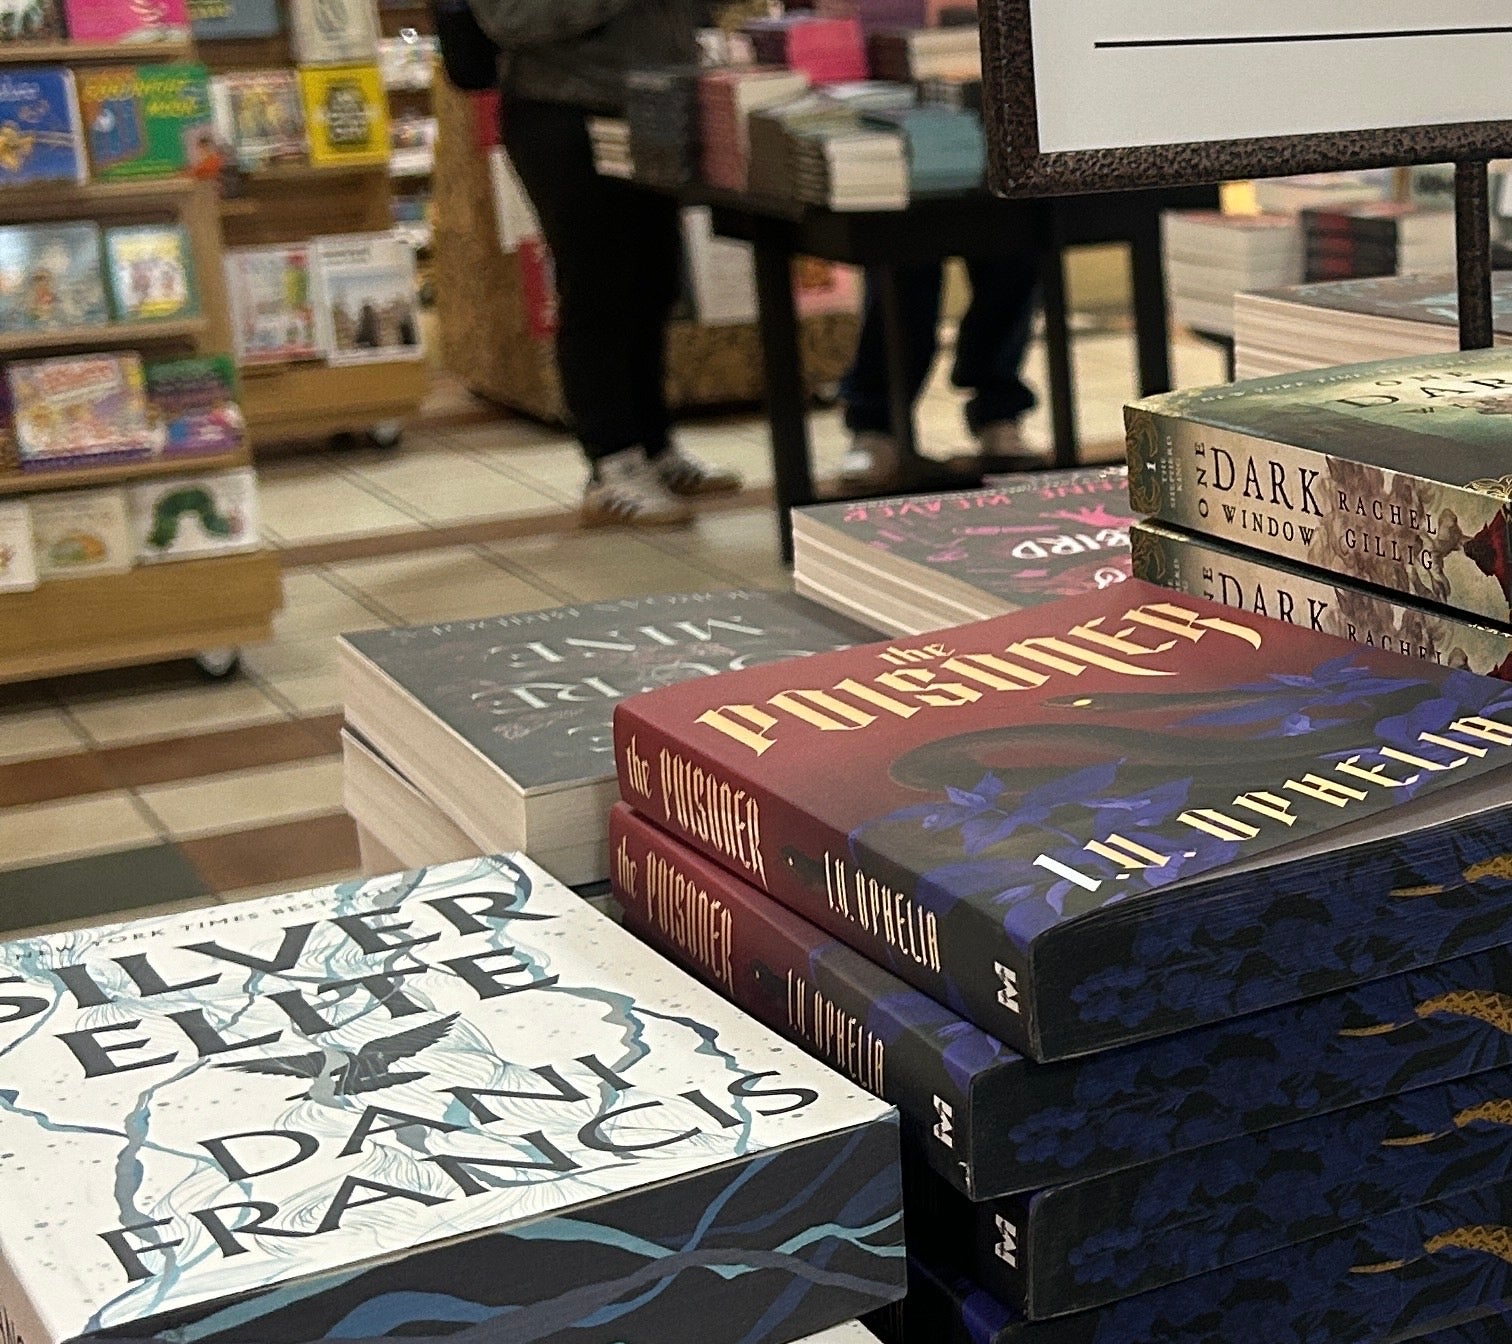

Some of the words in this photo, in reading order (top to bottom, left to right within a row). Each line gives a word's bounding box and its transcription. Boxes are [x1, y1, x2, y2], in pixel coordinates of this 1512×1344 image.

[1373, 370, 1476, 387] ONE
[1195, 442, 1209, 518] ONE
[1210, 446, 1324, 518] DARK
[1337, 489, 1439, 536] RACHEL
[1222, 503, 1317, 547] WINDOW
[1344, 527, 1435, 572] GILLIG
[1217, 572, 1329, 633] DARK
[489, 615, 765, 668] MINE
[877, 641, 958, 667] the
[694, 601, 1263, 757] POISONER
[625, 733, 652, 801] the
[659, 746, 770, 891] POISONER
[855, 868, 942, 975] OPHELIA
[184, 911, 261, 933] TIMES
[616, 833, 639, 898] the
[645, 851, 736, 996] POISONER
[810, 989, 885, 1098] OPHELIA
[54, 947, 562, 1080] ELITE
[198, 1053, 637, 1184] DANI
[98, 1069, 820, 1284] FRANCIS
